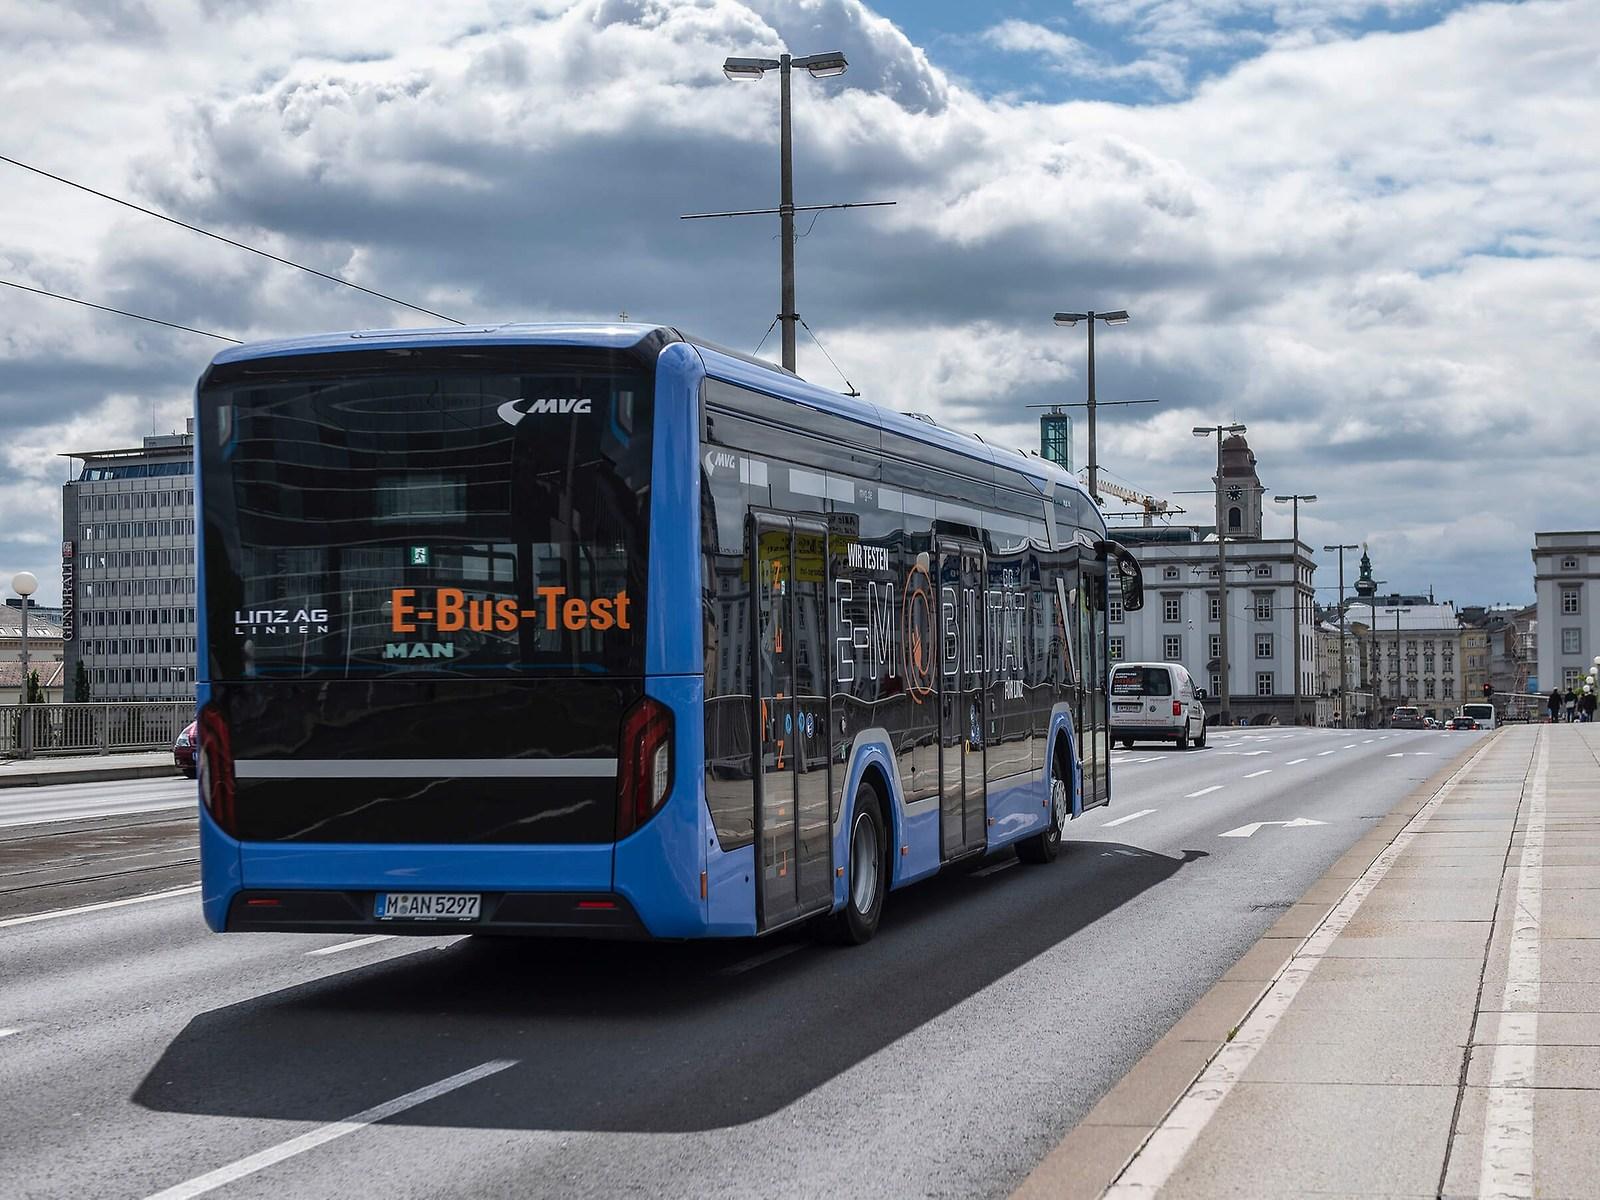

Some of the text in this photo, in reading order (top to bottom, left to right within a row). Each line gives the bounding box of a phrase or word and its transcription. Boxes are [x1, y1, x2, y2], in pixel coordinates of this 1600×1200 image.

[526, 399, 591, 413] MVG
[715, 452, 735, 469] MVG
[847, 542, 863, 568] WIR
[863, 545, 889, 571] TESTEN
[62, 563, 73, 641] GENERALI
[392, 586, 631, 633] E-Bus-Test
[235, 609, 328, 624] LINZ AG
[235, 625, 328, 635] LINIEN
[384, 642, 454, 659] MAN
[387, 896, 478, 914] M AN 5297
